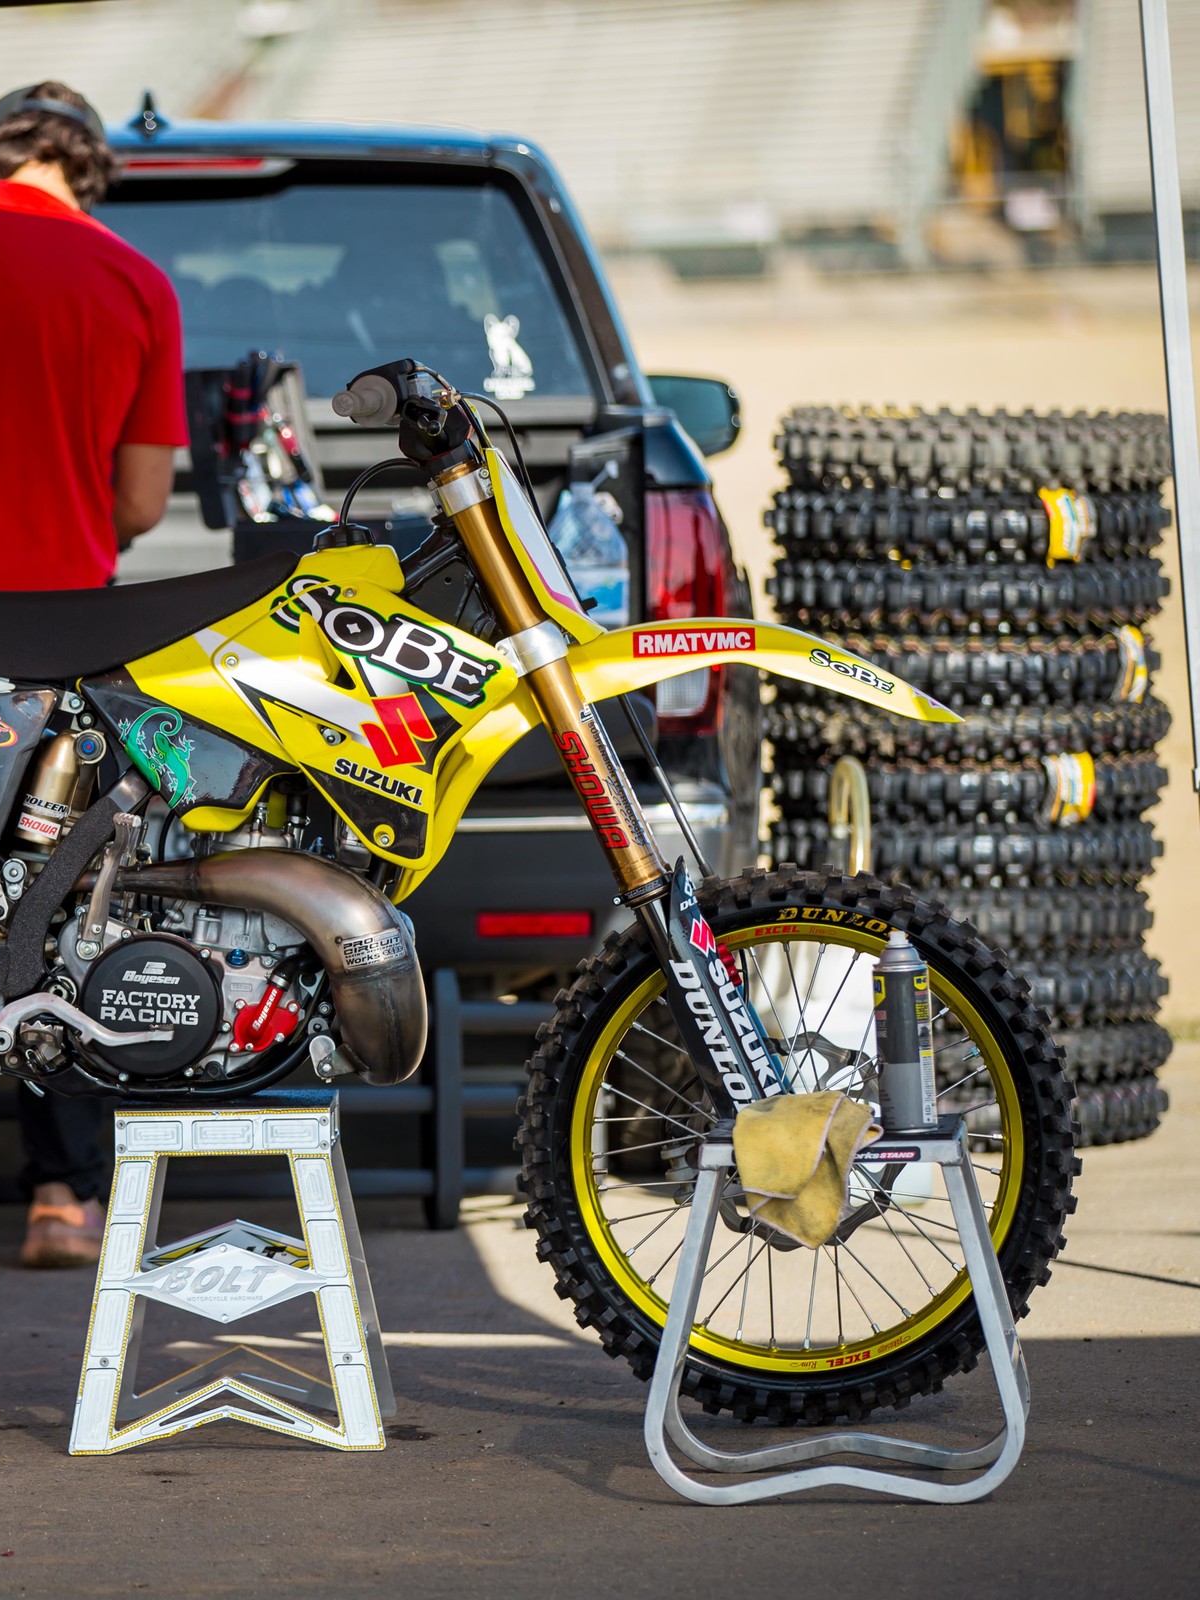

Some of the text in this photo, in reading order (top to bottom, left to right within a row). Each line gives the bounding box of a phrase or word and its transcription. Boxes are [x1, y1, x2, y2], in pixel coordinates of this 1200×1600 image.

[637, 631, 751, 655] RMATVMC
[334, 757, 423, 806] SUZUKI
[553, 730, 630, 848] SHOWA
[20, 816, 59, 836] SHOWA
[754, 925, 800, 937] EXCEL
[343, 937, 373, 950] PRO
[344, 936, 400, 956] CIRCUIT
[346, 953, 380, 966] Works
[121, 970, 181, 985] Boyesen
[101, 989, 201, 1010] FACTORY
[252, 988, 278, 1031] Boyesen
[100, 1006, 199, 1026] RACING
[669, 959, 761, 1113] DUNLO
[708, 957, 783, 1098] SUZUKI
[160, 1265, 279, 1294] BOLT
[826, 1350, 871, 1368] EXCEL
